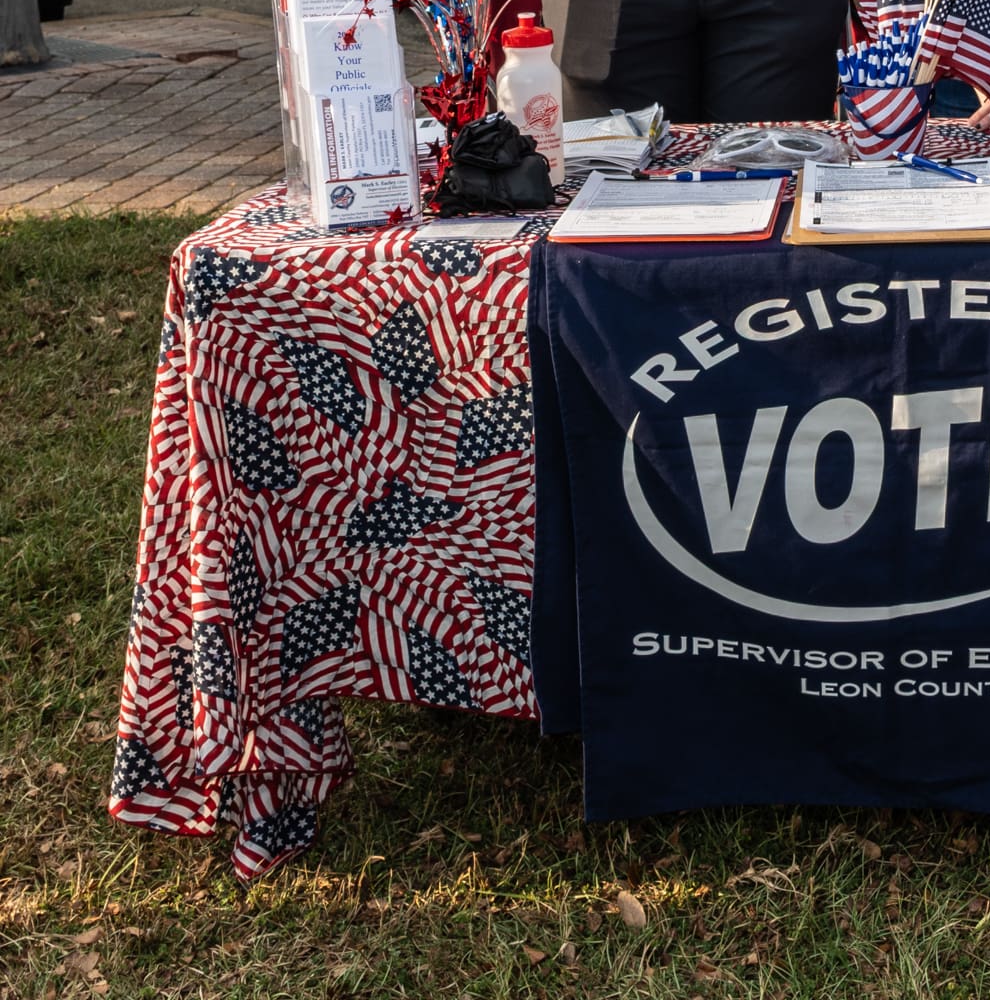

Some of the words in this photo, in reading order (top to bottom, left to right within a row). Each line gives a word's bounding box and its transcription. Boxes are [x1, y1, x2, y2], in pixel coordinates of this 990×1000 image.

[337, 56, 362, 65] Your
[336, 69, 366, 80] Public
[324, 106, 337, 166] INFORMATION
[632, 631, 885, 671] SUPERVISOR
[900, 650, 954, 670] OF
[800, 677, 882, 699] LEON
